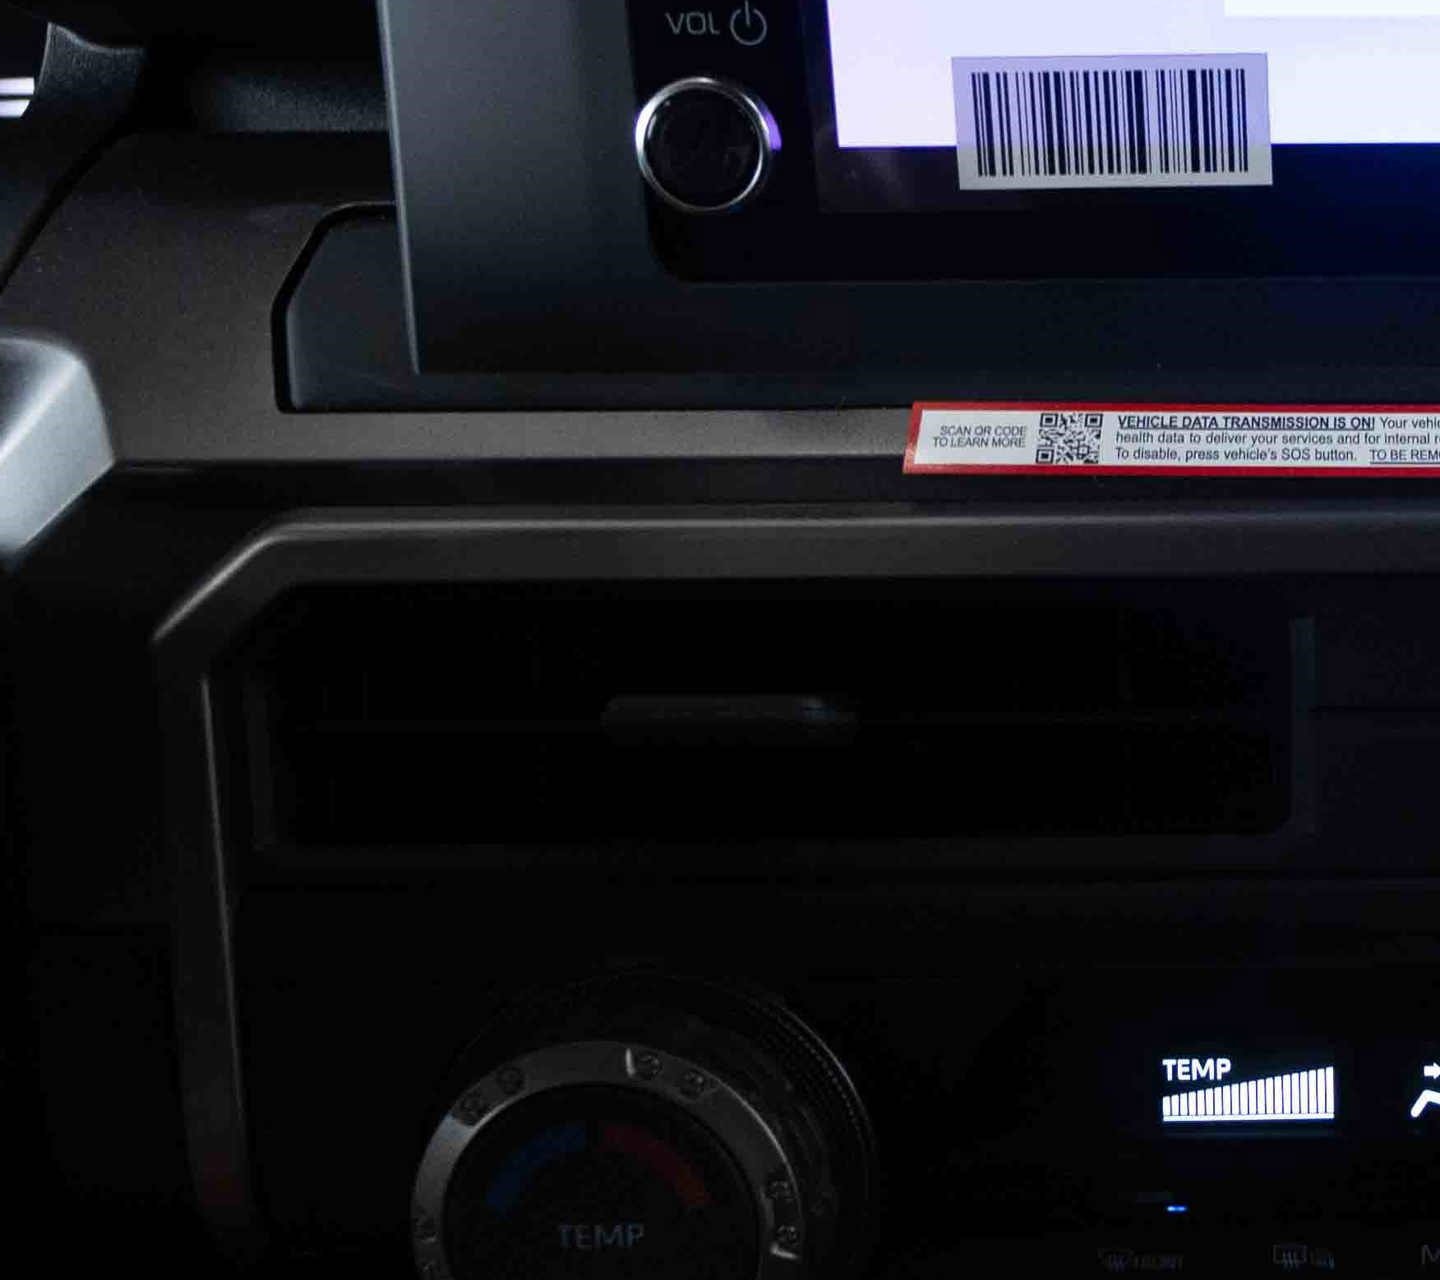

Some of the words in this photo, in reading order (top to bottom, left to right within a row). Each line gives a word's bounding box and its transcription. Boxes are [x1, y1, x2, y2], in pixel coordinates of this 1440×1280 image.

[664, 12, 721, 35] VOL
[940, 426, 972, 436] SCAN
[994, 425, 1027, 436] CODE
[1118, 416, 1177, 429] VEHICLE
[1182, 416, 1218, 429] DATA
[1222, 416, 1330, 429] TRANSMISSION
[1334, 416, 1347, 429] IS
[1352, 416, 1375, 429] ON!
[1380, 417, 1408, 429] Your
[934, 437, 948, 448] TO
[950, 437, 989, 448] LEARN
[992, 437, 1026, 448] MORE
[1116, 431, 1153, 444] health
[1158, 431, 1184, 444] data
[1189, 432, 1201, 444] to
[1205, 431, 1246, 444] deliver
[1251, 434, 1278, 447] your
[1281, 432, 1333, 444] services
[1337, 431, 1359, 444] and
[1364, 431, 1380, 444] for
[1384, 431, 1430, 444] internal
[1116, 448, 1129, 460] To
[1133, 447, 1182, 462] disable,
[1185, 450, 1220, 464] press
[1224, 447, 1277, 460] vehicle's
[1281, 447, 1311, 460] SOS
[1314, 447, 1357, 461] button.
[1370, 449, 1387, 460] TO
[1390, 449, 1407, 460] BE
[1162, 1058, 1232, 1082] TEMP
[558, 1222, 646, 1251] TEMP
